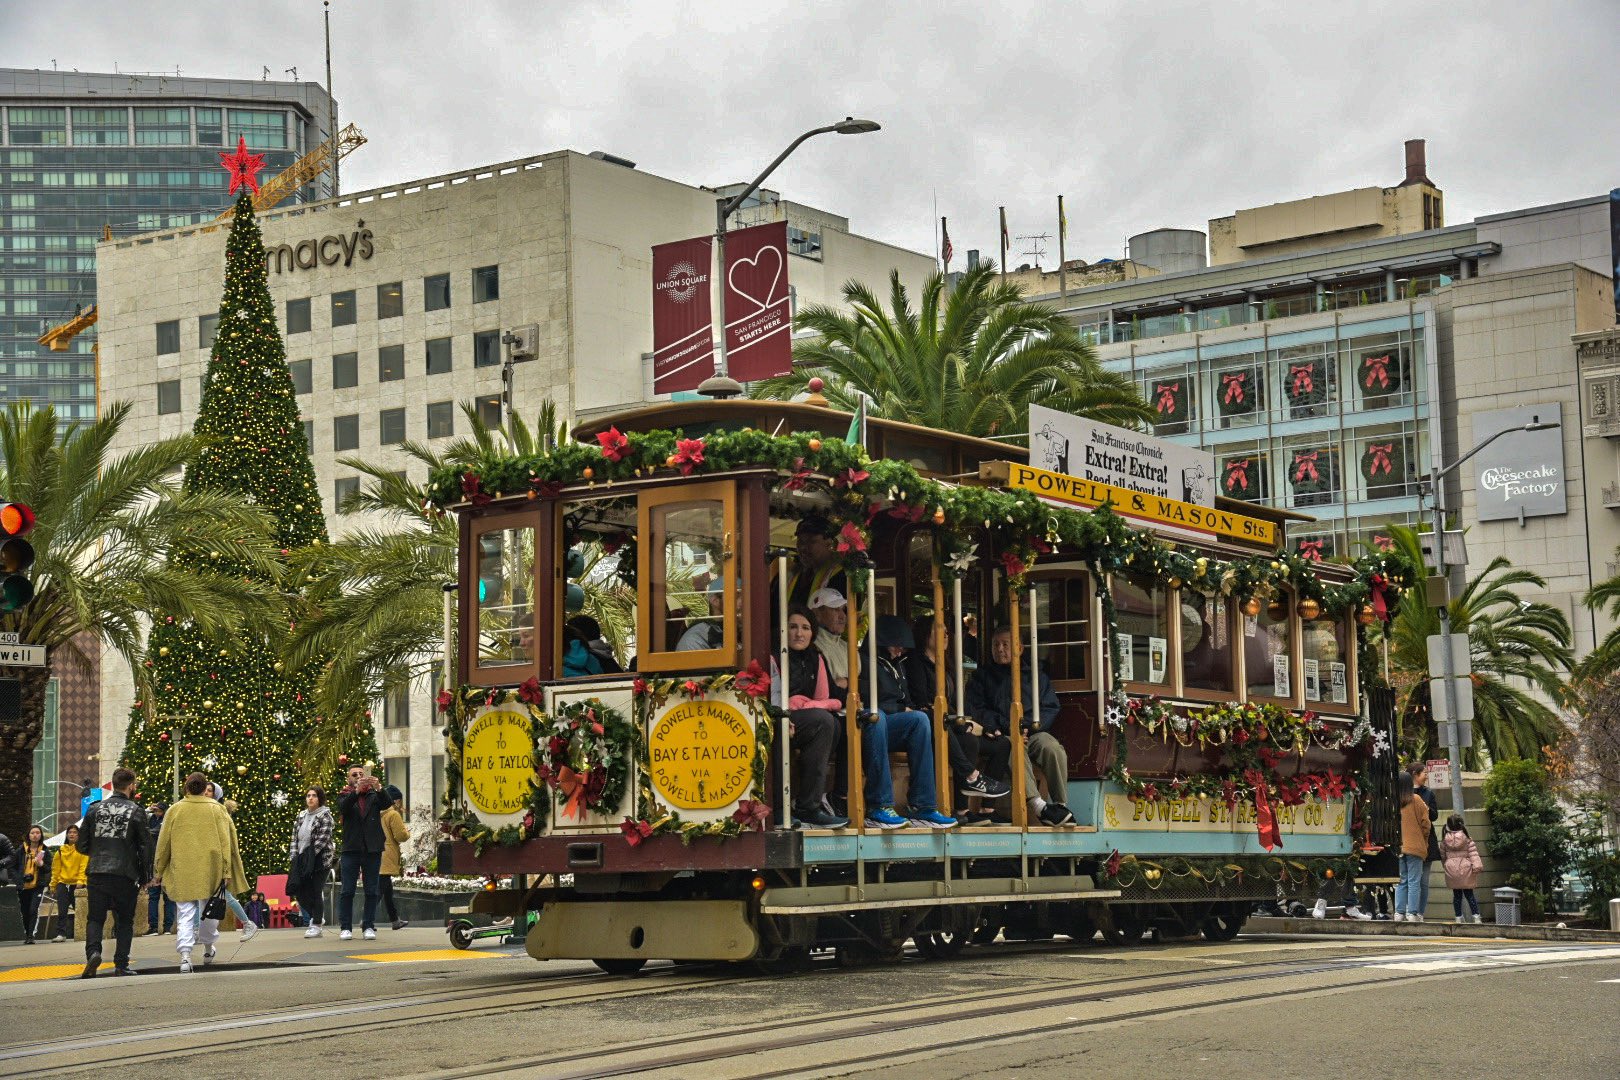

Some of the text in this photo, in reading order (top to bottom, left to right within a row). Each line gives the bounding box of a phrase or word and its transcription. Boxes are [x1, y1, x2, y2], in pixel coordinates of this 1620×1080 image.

[656, 274, 707, 290] UNION SQUARE
[734, 309, 782, 336] SAN FRANCISCO
[739, 318, 782, 343] STARTS HERE
[1091, 429, 1163, 460] San Francisco Chronicle
[1085, 445, 1168, 484] Extra! Extra!
[1500, 466, 1512, 474] The
[1085, 469, 1111, 486] Read
[1113, 477, 1126, 489] all
[1480, 464, 1557, 491] Cheesecake
[1497, 480, 1559, 502] Factory
[1018, 468, 1268, 538] POWELL & MASON Sts.
[1, 633, 17, 643] 400
[0, 649, 31, 661] well
[467, 716, 494, 749] POWELL
[497, 715, 503, 726] &
[656, 705, 747, 741] POWELL & MARKET
[496, 740, 507, 750] TO
[693, 730, 708, 740] TO
[466, 756, 484, 770] BAY
[487, 755, 495, 770] &
[654, 744, 748, 762] BAY & TAYLOR
[494, 775, 507, 785] VIA
[656, 767, 697, 803] POWELL
[708, 765, 747, 801] MASON
[691, 769, 710, 778] VIA
[467, 776, 531, 810] POWELL & MASN
[1132, 799, 1201, 823] POWELL
[1303, 803, 1324, 826] CO.
